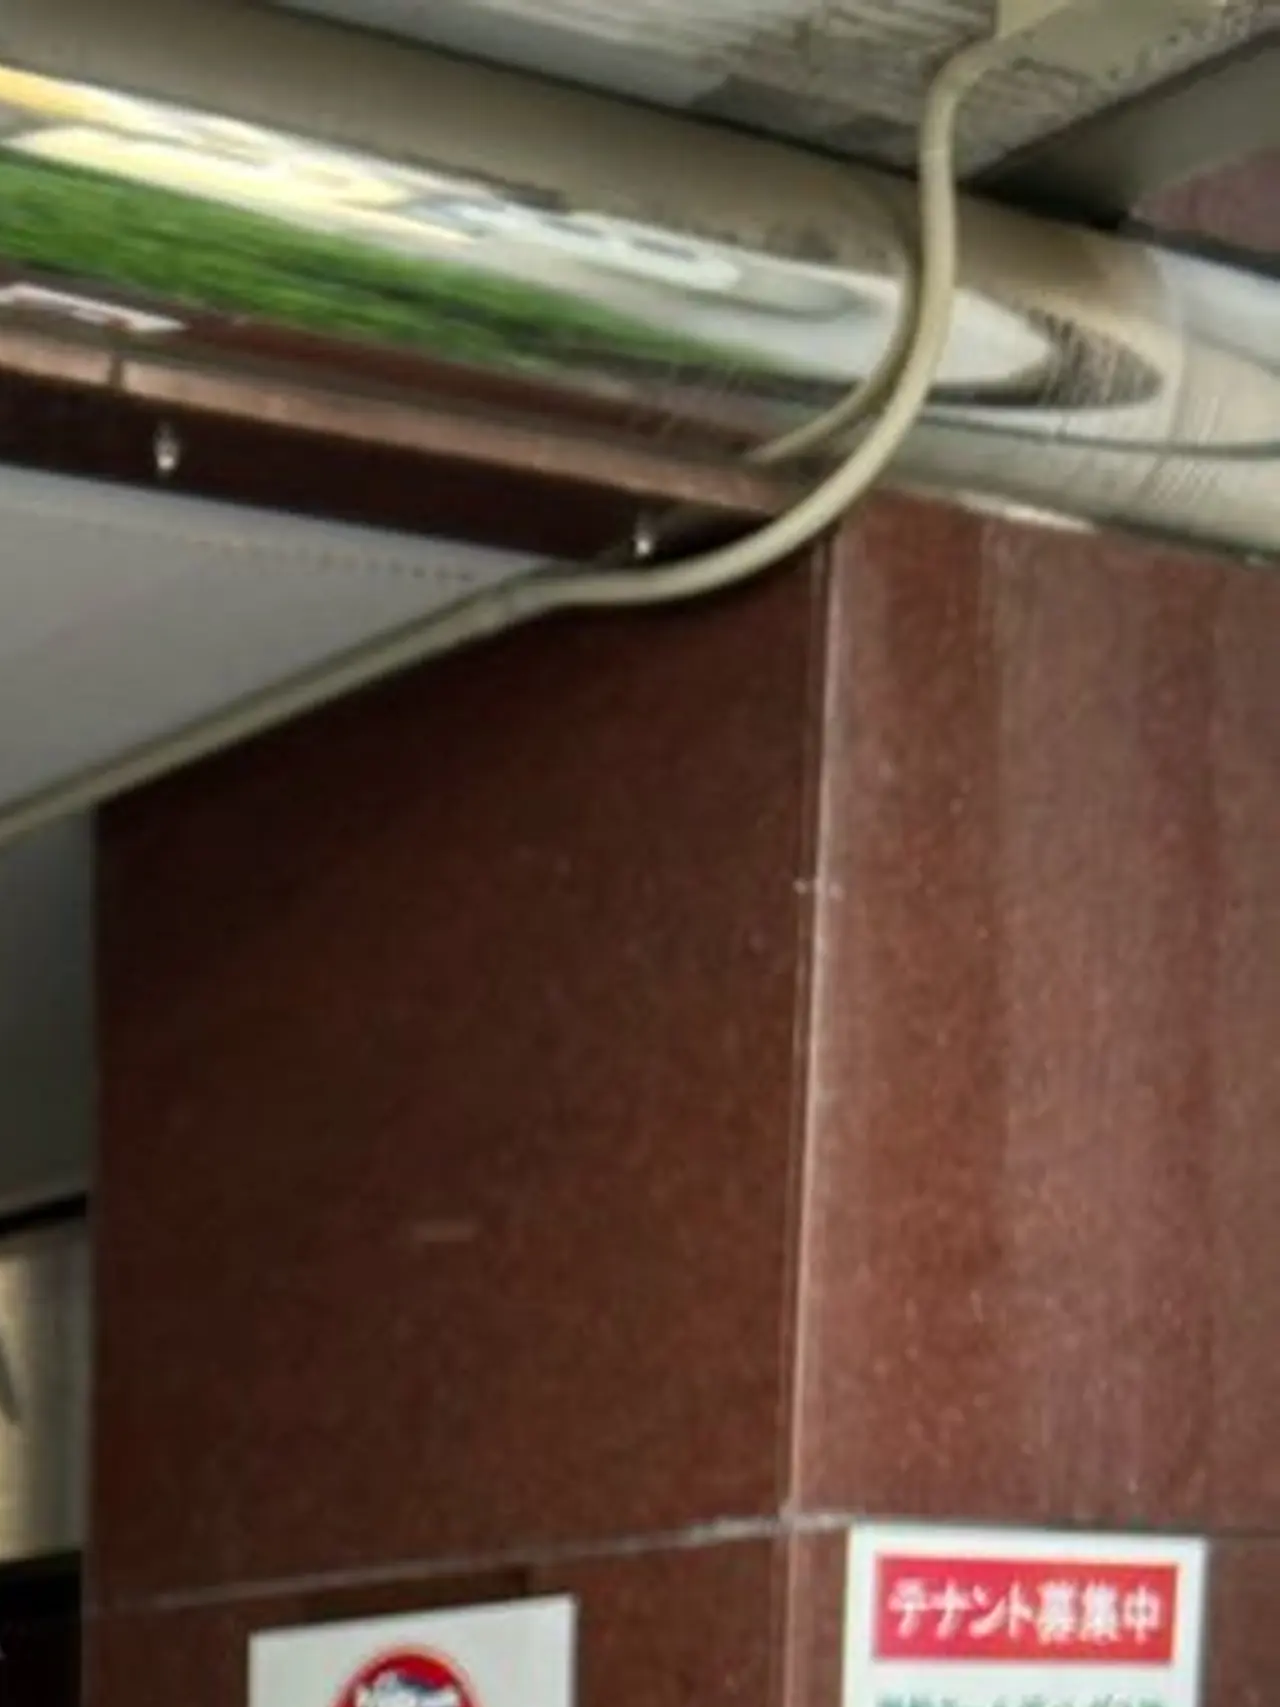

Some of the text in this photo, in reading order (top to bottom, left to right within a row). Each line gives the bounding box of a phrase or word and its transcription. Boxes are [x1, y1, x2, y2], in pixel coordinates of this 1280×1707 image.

[887, 1577, 1162, 1645] テナント募集中
